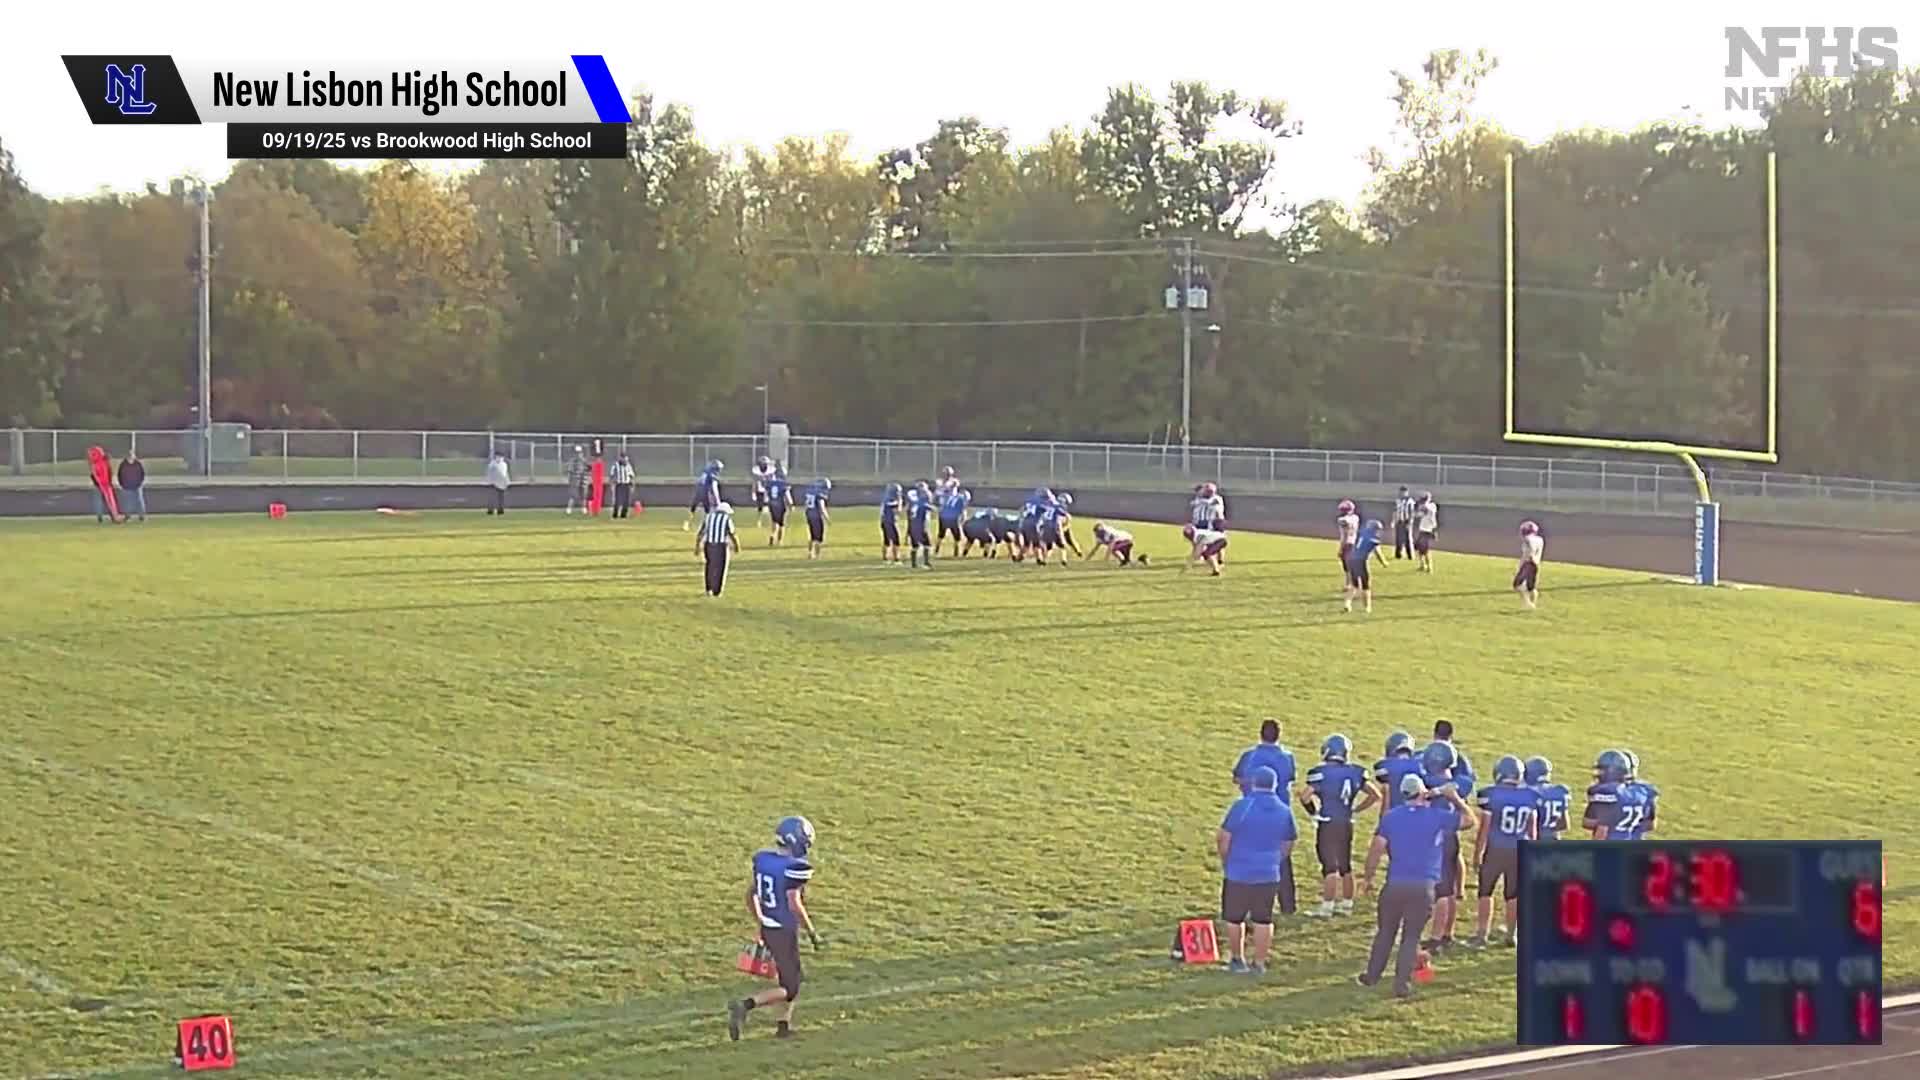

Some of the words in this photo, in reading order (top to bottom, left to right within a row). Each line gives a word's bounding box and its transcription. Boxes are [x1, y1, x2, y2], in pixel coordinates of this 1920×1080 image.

[594, 439, 602, 454] 1
[1341, 778, 1352, 806] 4
[1501, 805, 1531, 834] 60
[1543, 800, 1563, 828] 15
[756, 872, 777, 909] 13
[1185, 925, 1213, 954] 30
[188, 1025, 229, 1062] 40
